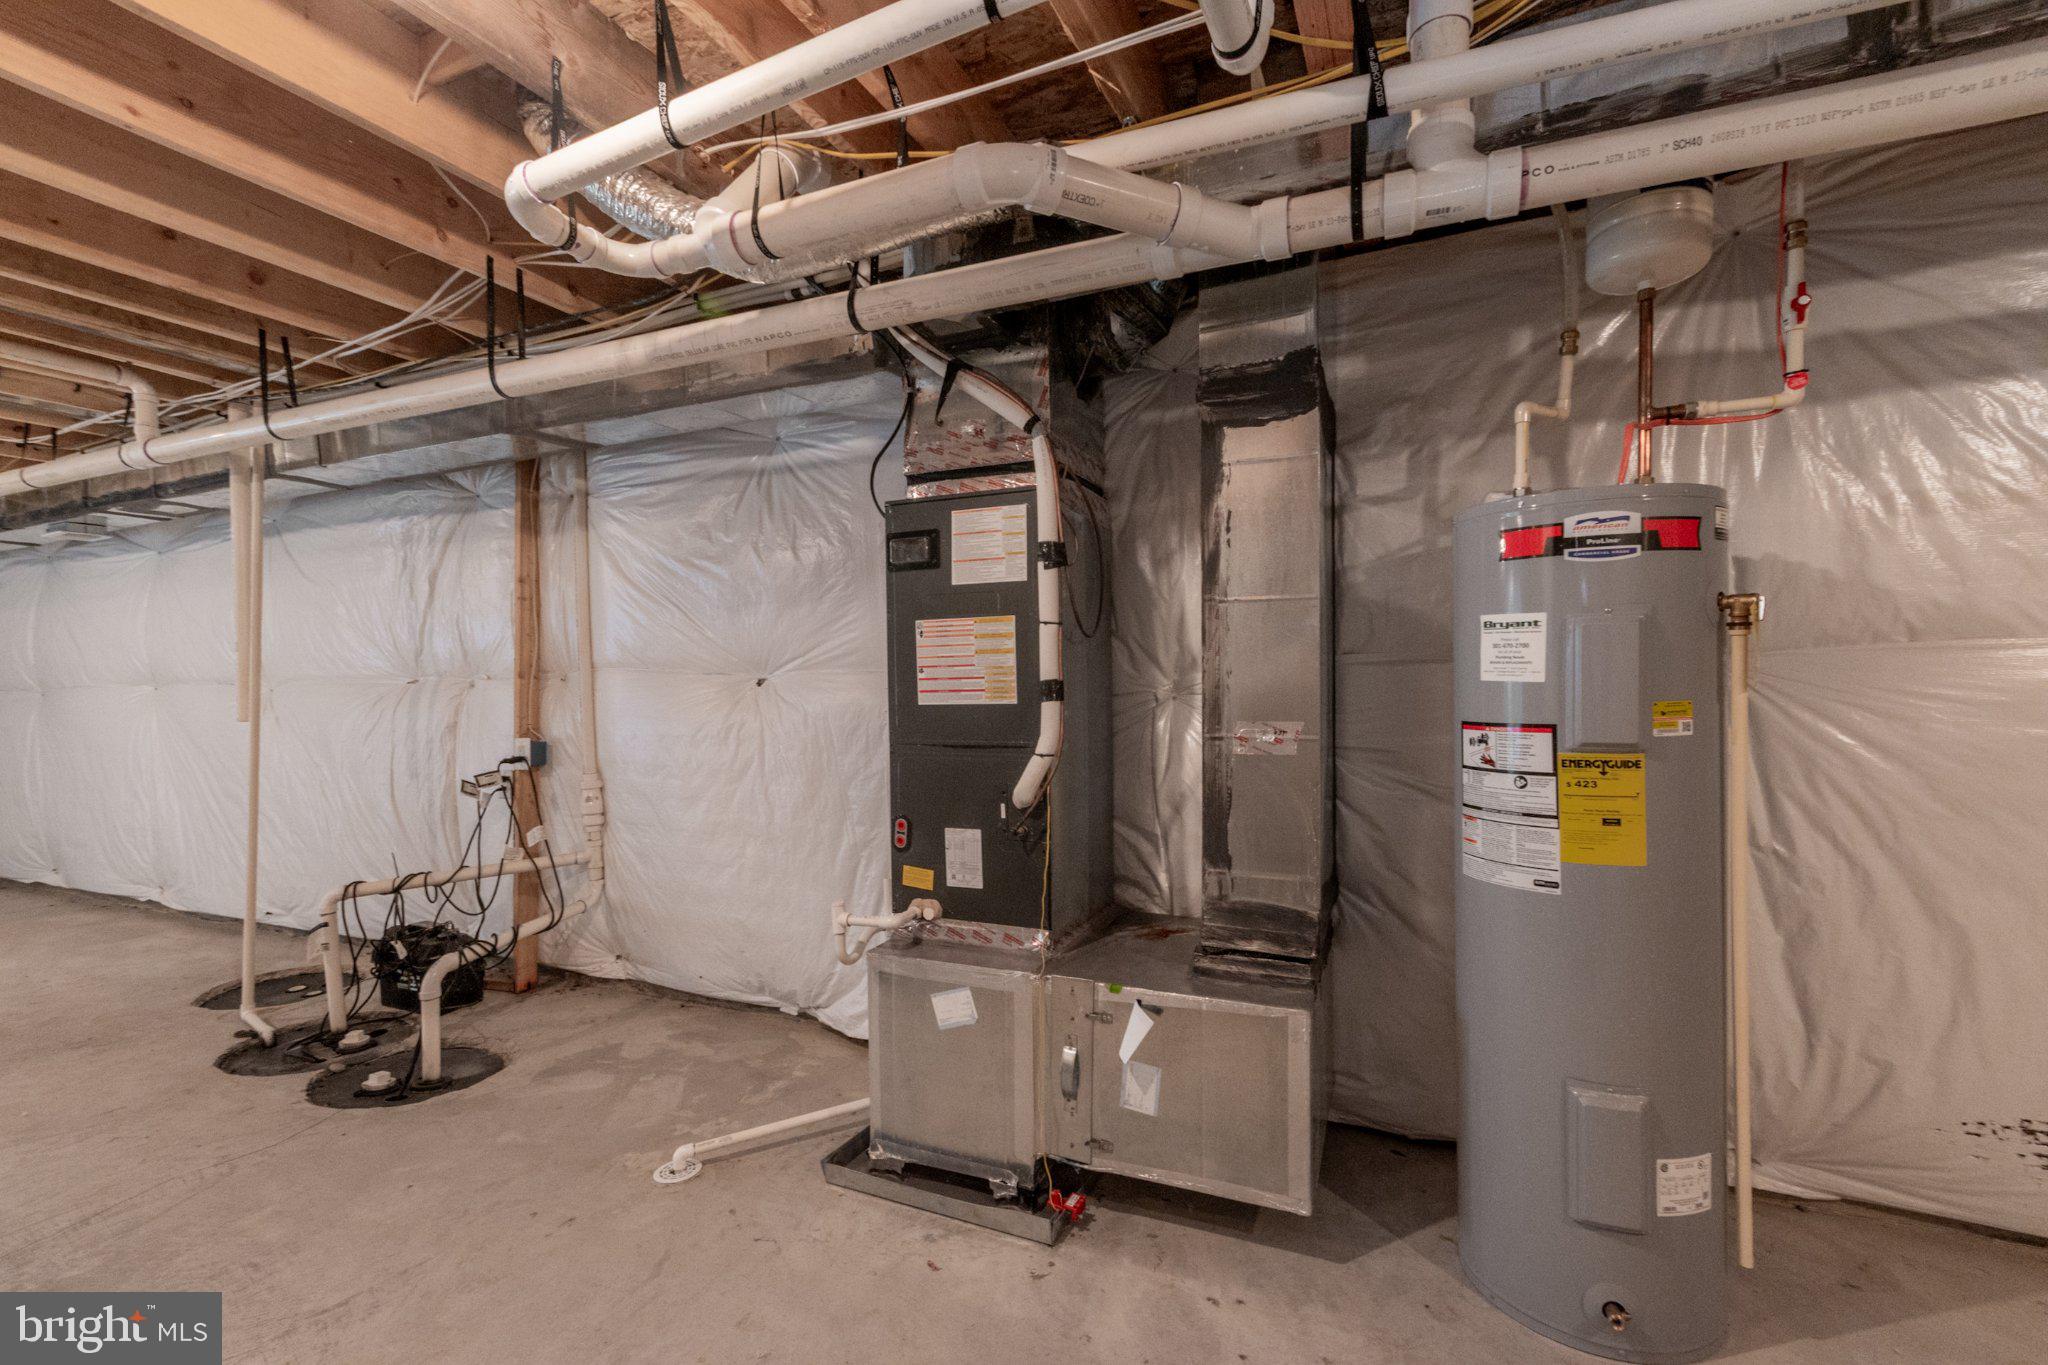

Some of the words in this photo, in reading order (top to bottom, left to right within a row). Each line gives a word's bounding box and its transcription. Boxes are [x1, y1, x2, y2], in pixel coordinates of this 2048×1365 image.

[658, 81, 667, 107] SIOUX
[1373, 80, 1386, 107] SIOUX
[1672, 135, 1703, 151] SCH40
[755, 330, 793, 345] NAPCO
[1572, 521, 1630, 532] american
[1483, 619, 1543, 629] Bryant
[1561, 759, 1642, 770] ENERGYGUIDE
[1574, 780, 1598, 788] 423
